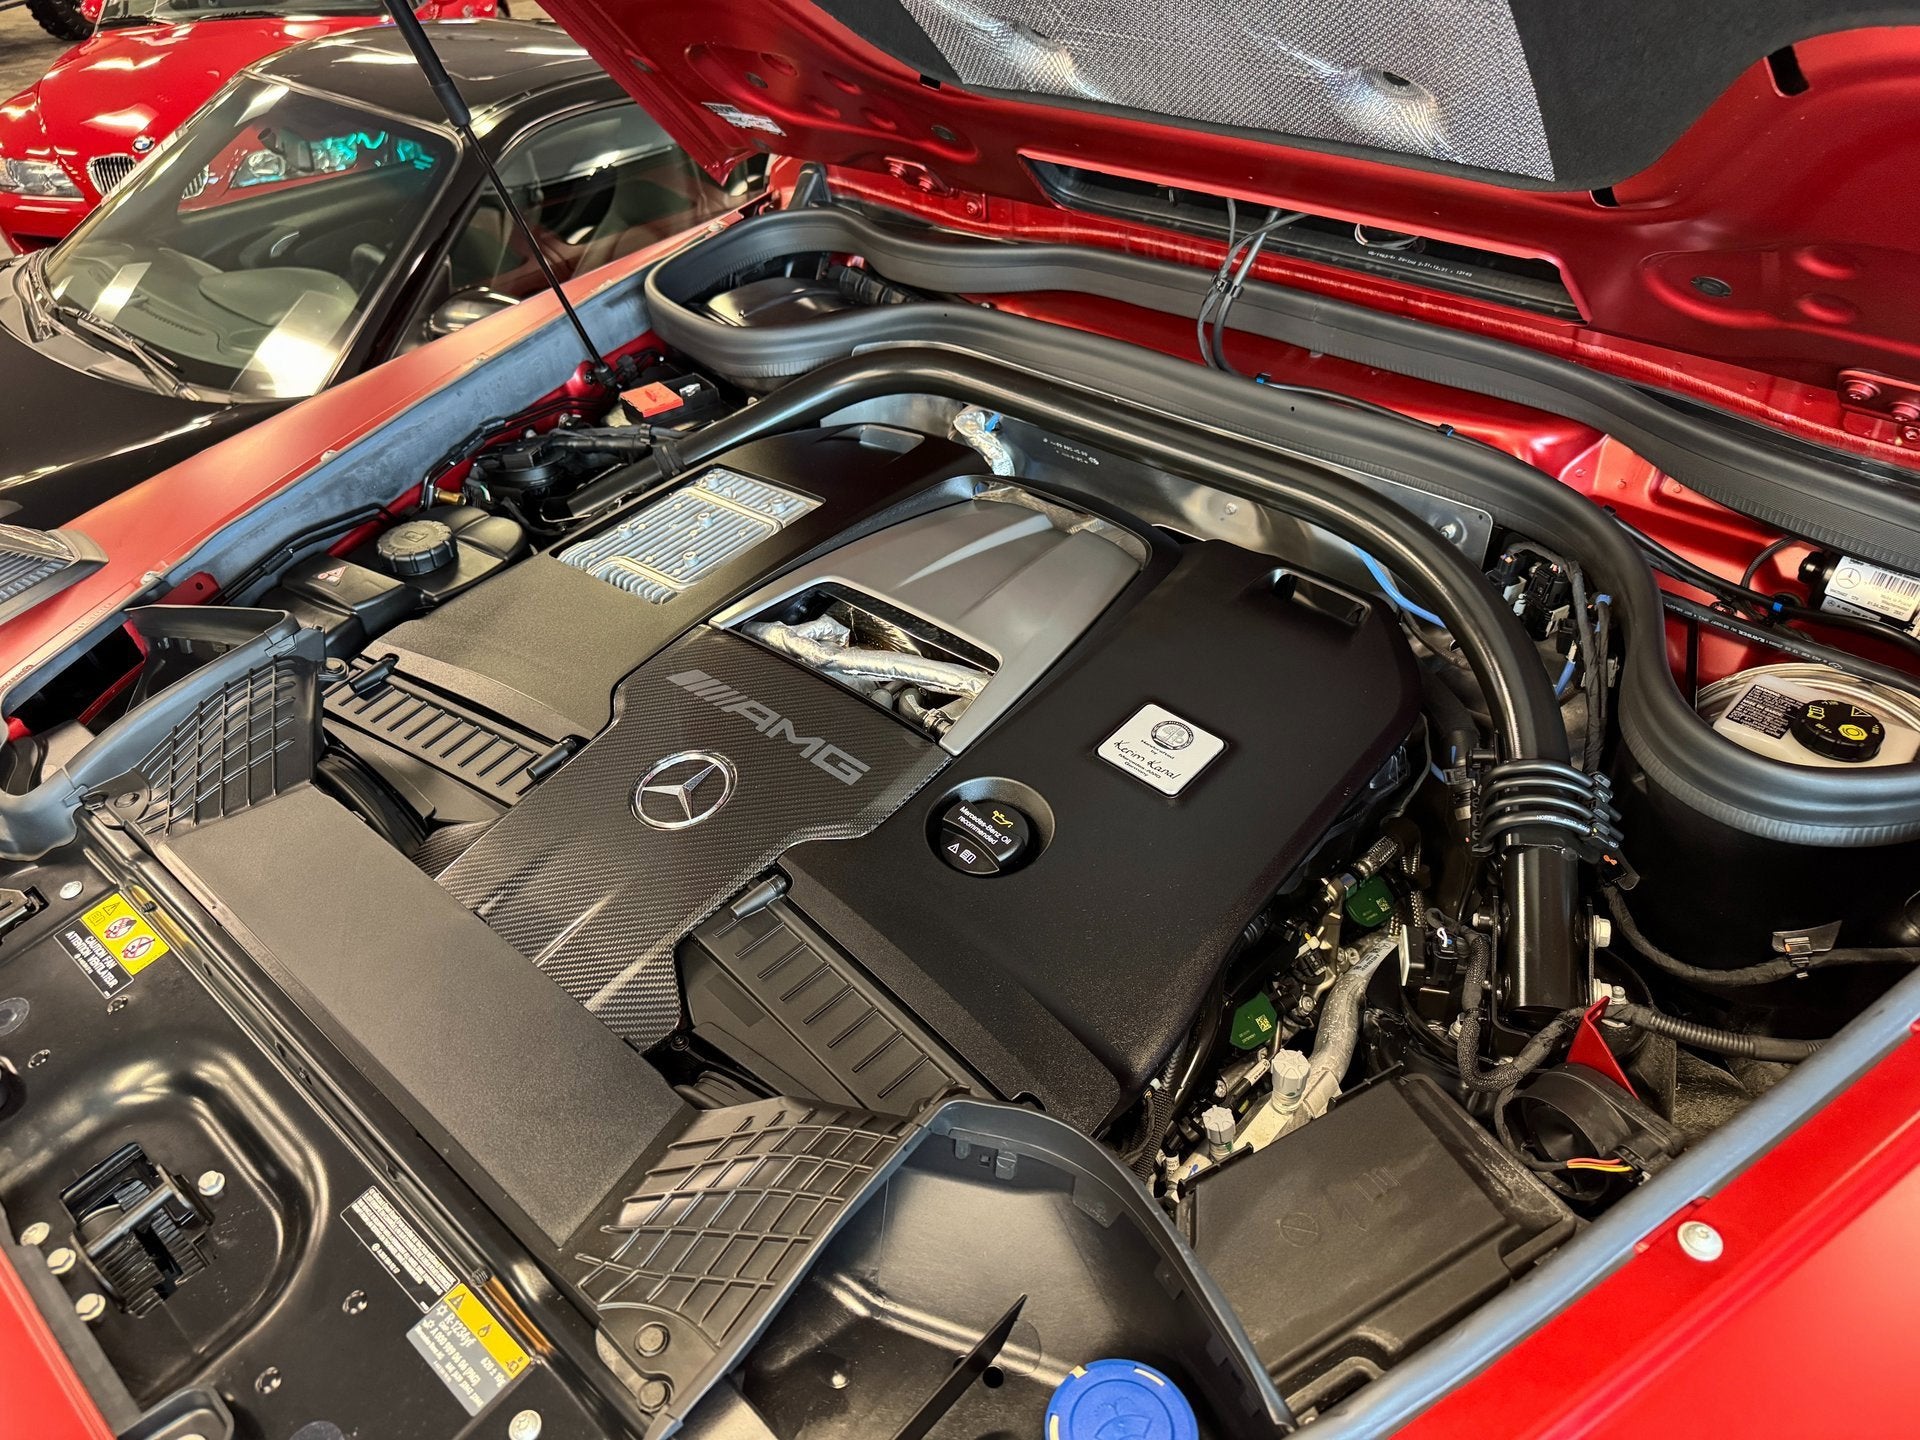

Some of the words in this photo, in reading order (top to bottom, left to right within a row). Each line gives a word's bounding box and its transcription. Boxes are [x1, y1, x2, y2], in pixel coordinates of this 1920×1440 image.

[721, 699, 872, 786] AMG
[1114, 740, 1145, 762] Kerim
[957, 815, 999, 846] recommended
[959, 806, 1002, 839] Mercedes-Benz
[1000, 834, 1012, 845] Oil
[65, 930, 93, 959] ATTENTION
[87, 953, 119, 988] VENTILATEUR
[444, 1313, 476, 1348] R-1234yf
